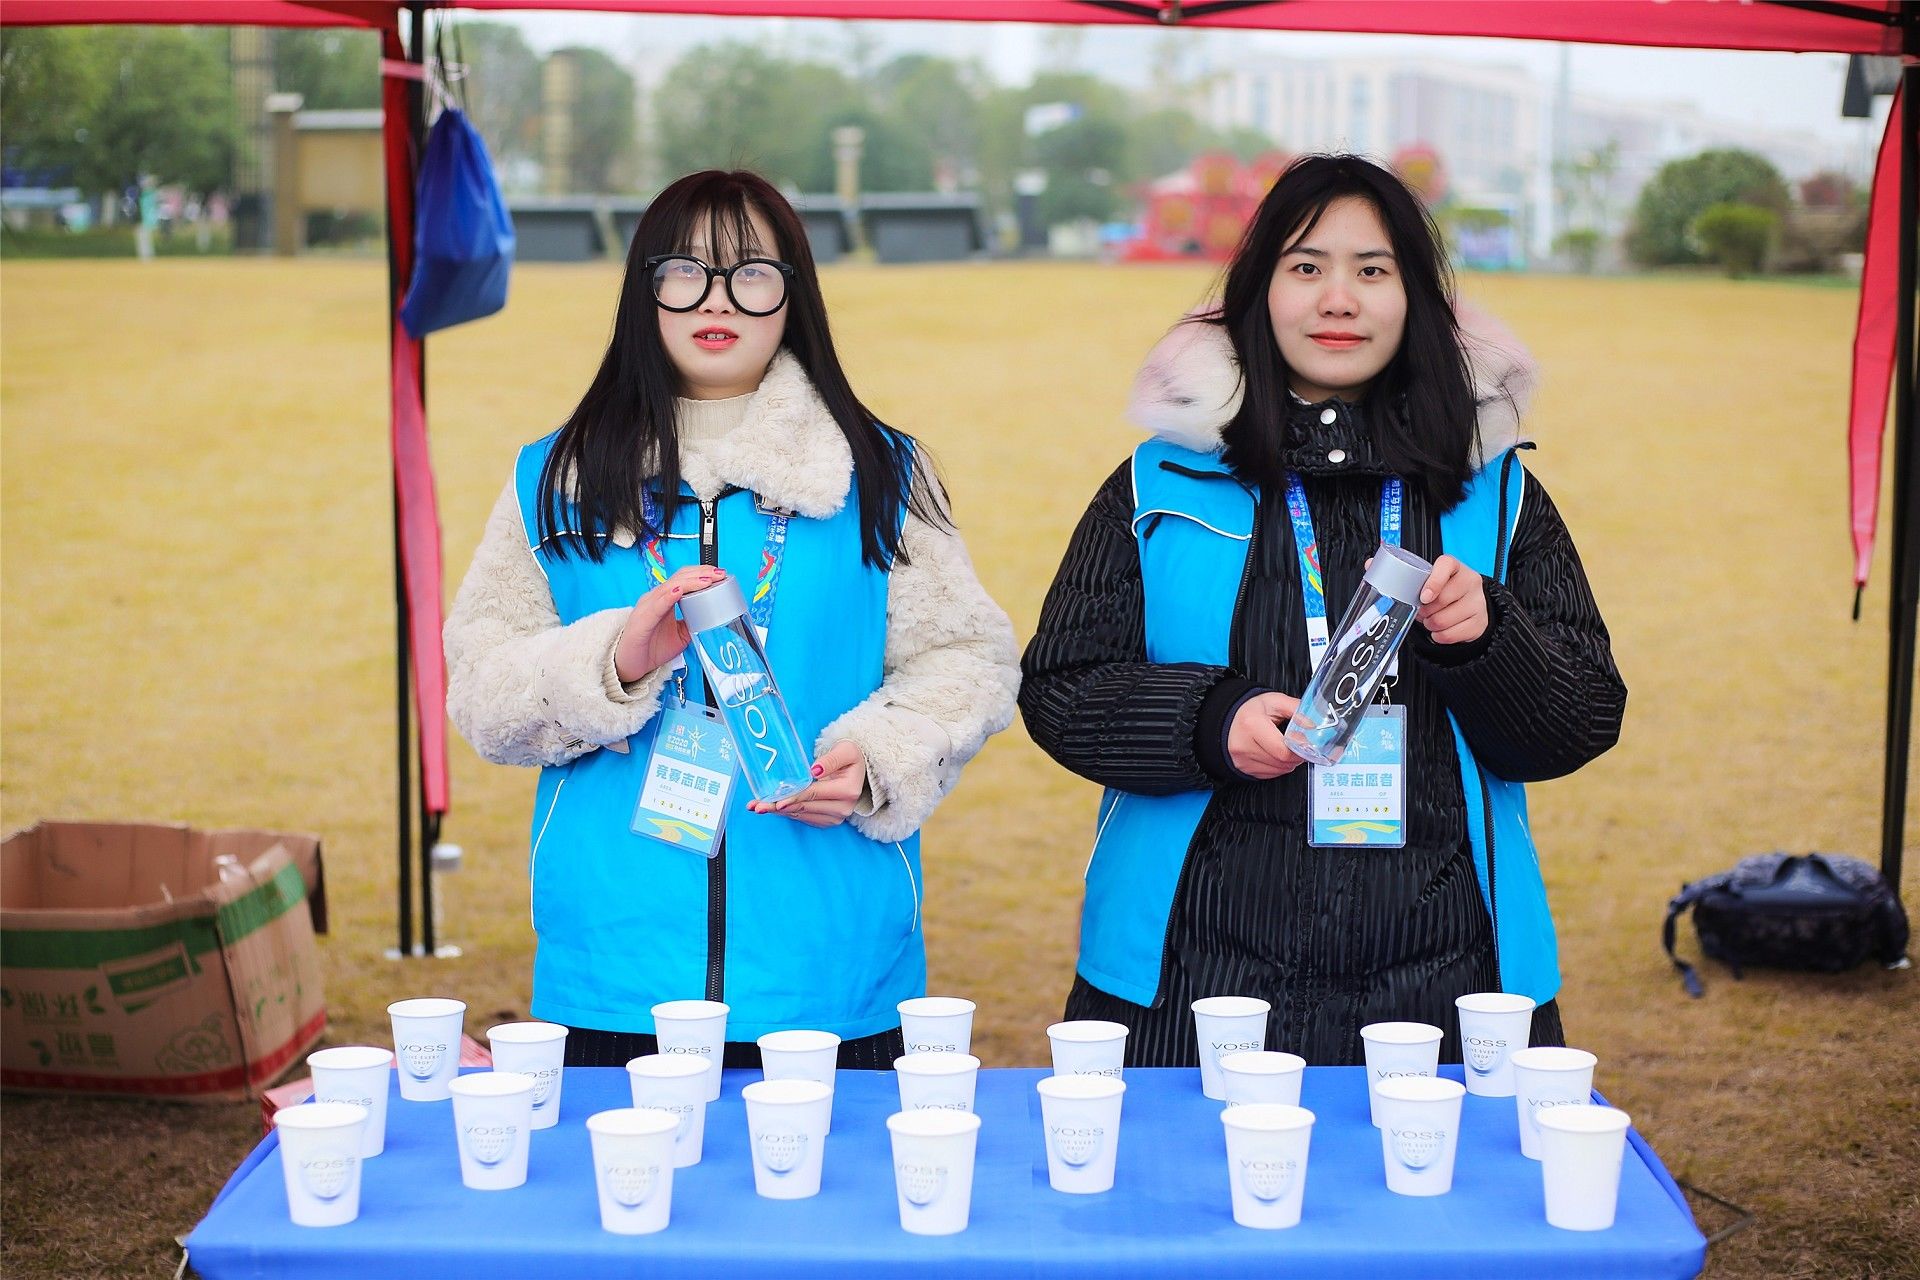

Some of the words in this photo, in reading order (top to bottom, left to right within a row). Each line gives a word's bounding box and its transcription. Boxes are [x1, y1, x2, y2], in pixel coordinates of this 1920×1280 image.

[1315, 613, 1389, 730] VOSS
[719, 640, 778, 771] VOSS
[655, 763, 722, 796] 竞赛志愿者
[1321, 772, 1393, 788] 竞赛志愿者
[1212, 1041, 1259, 1050] VOSS
[1463, 1036, 1507, 1047] VOSS
[399, 1043, 447, 1053] VOSS
[663, 1046, 710, 1054] VOSS
[908, 1043, 956, 1052] VOSS
[464, 1126, 516, 1136] VOSS
[1051, 1126, 1104, 1137] VOSS
[1391, 1128, 1446, 1140] VOSS
[754, 1132, 808, 1144] VOSS
[300, 1157, 356, 1169] VOSS
[1240, 1159, 1297, 1170] VOSS
[603, 1166, 660, 1177] VOSS
